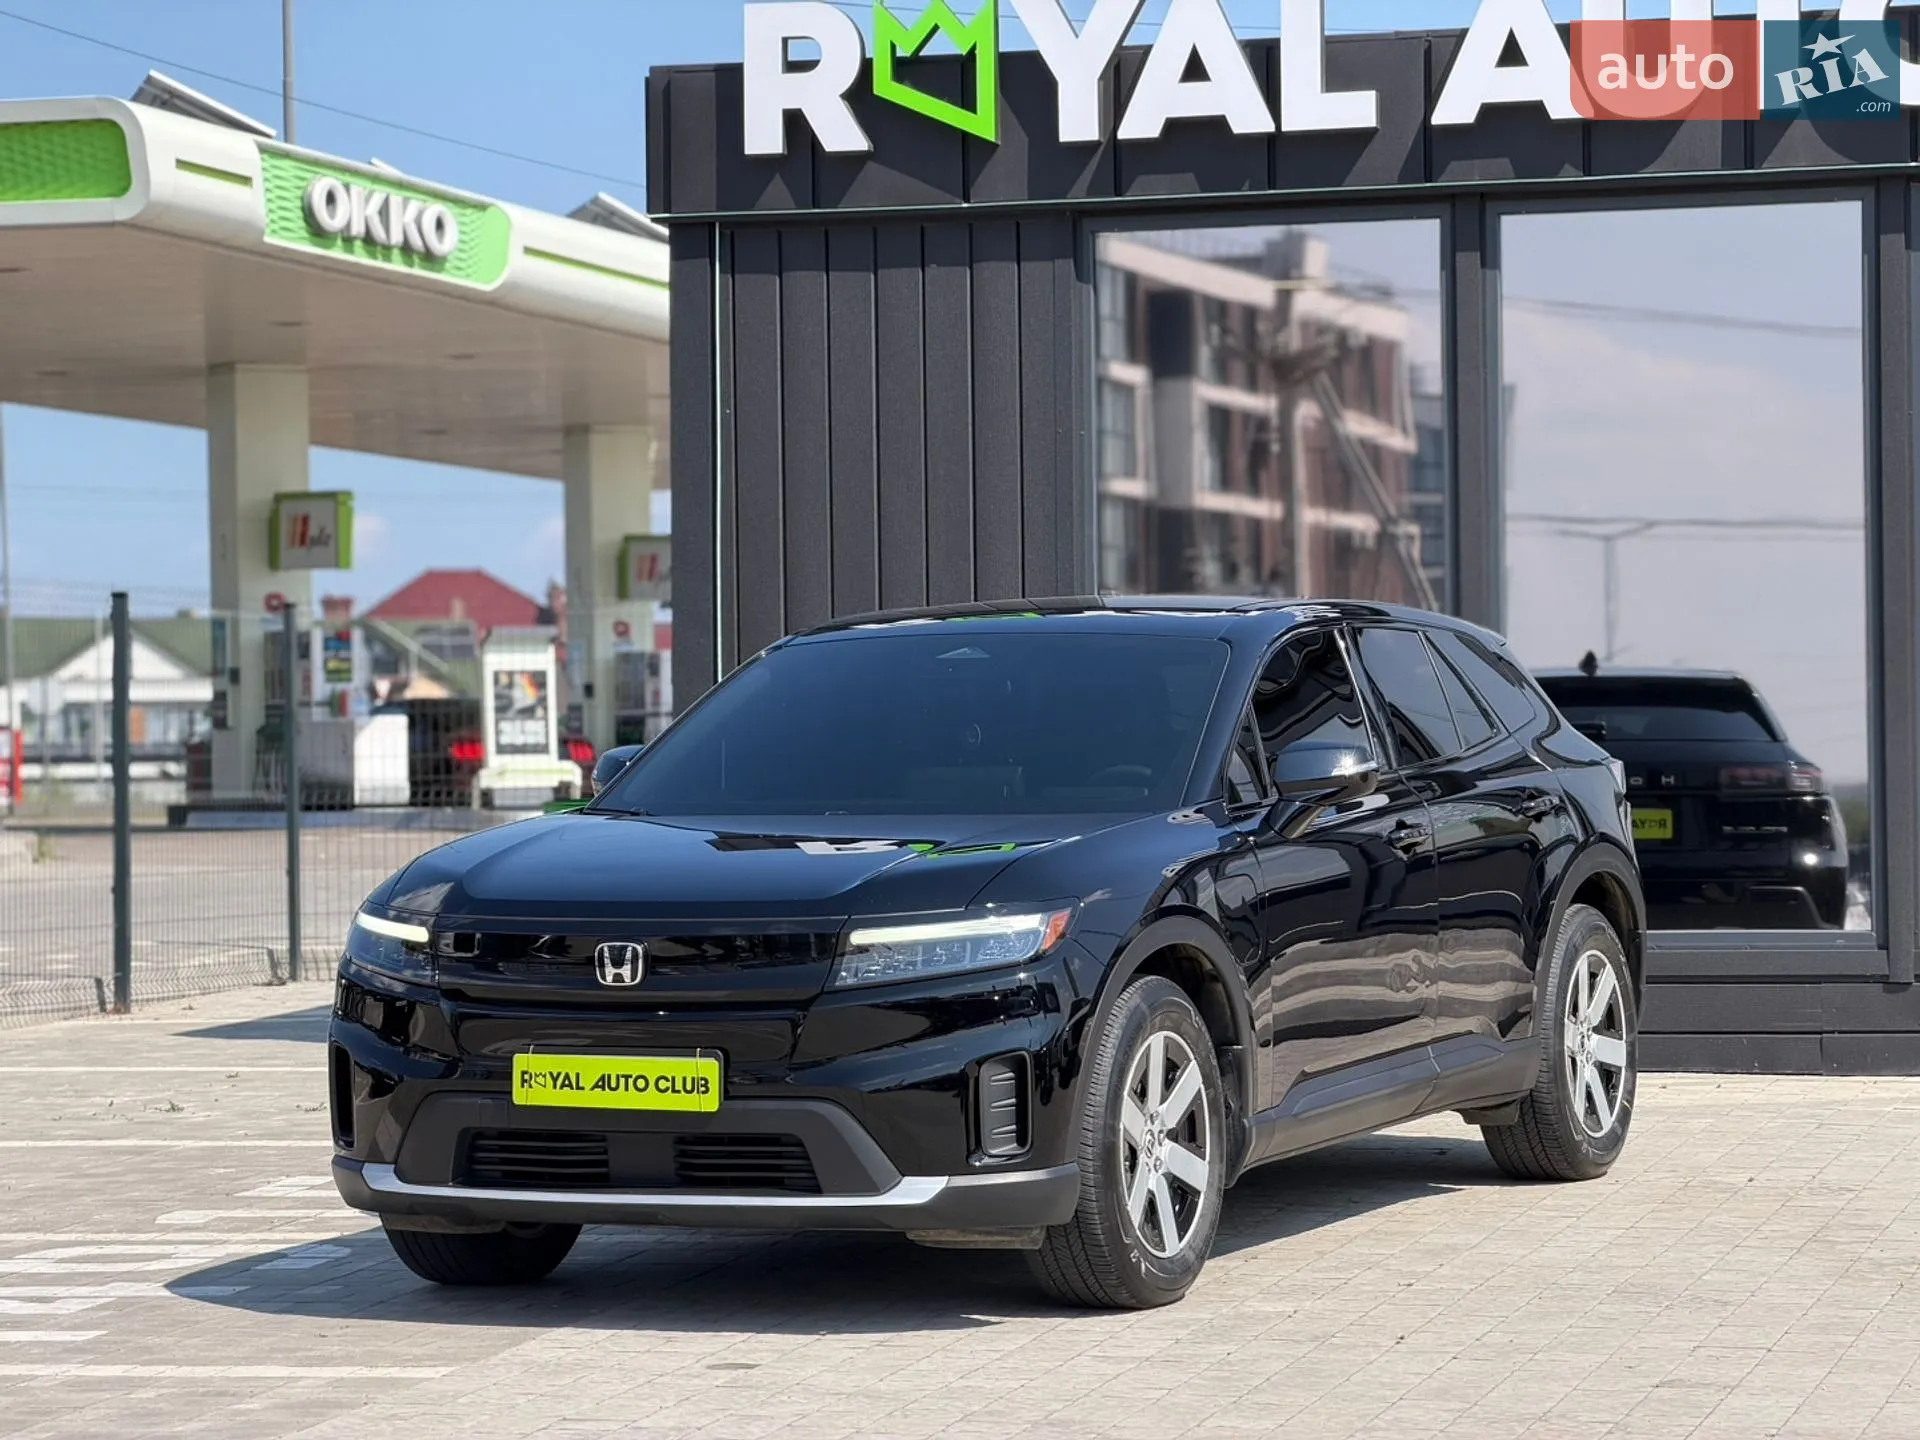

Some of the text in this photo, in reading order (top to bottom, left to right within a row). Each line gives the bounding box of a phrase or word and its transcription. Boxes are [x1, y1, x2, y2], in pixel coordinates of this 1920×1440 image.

[307, 176, 459, 258] OKKO
[590, 1073, 650, 1093] AUTO
[654, 1075, 711, 1095] CLUB
